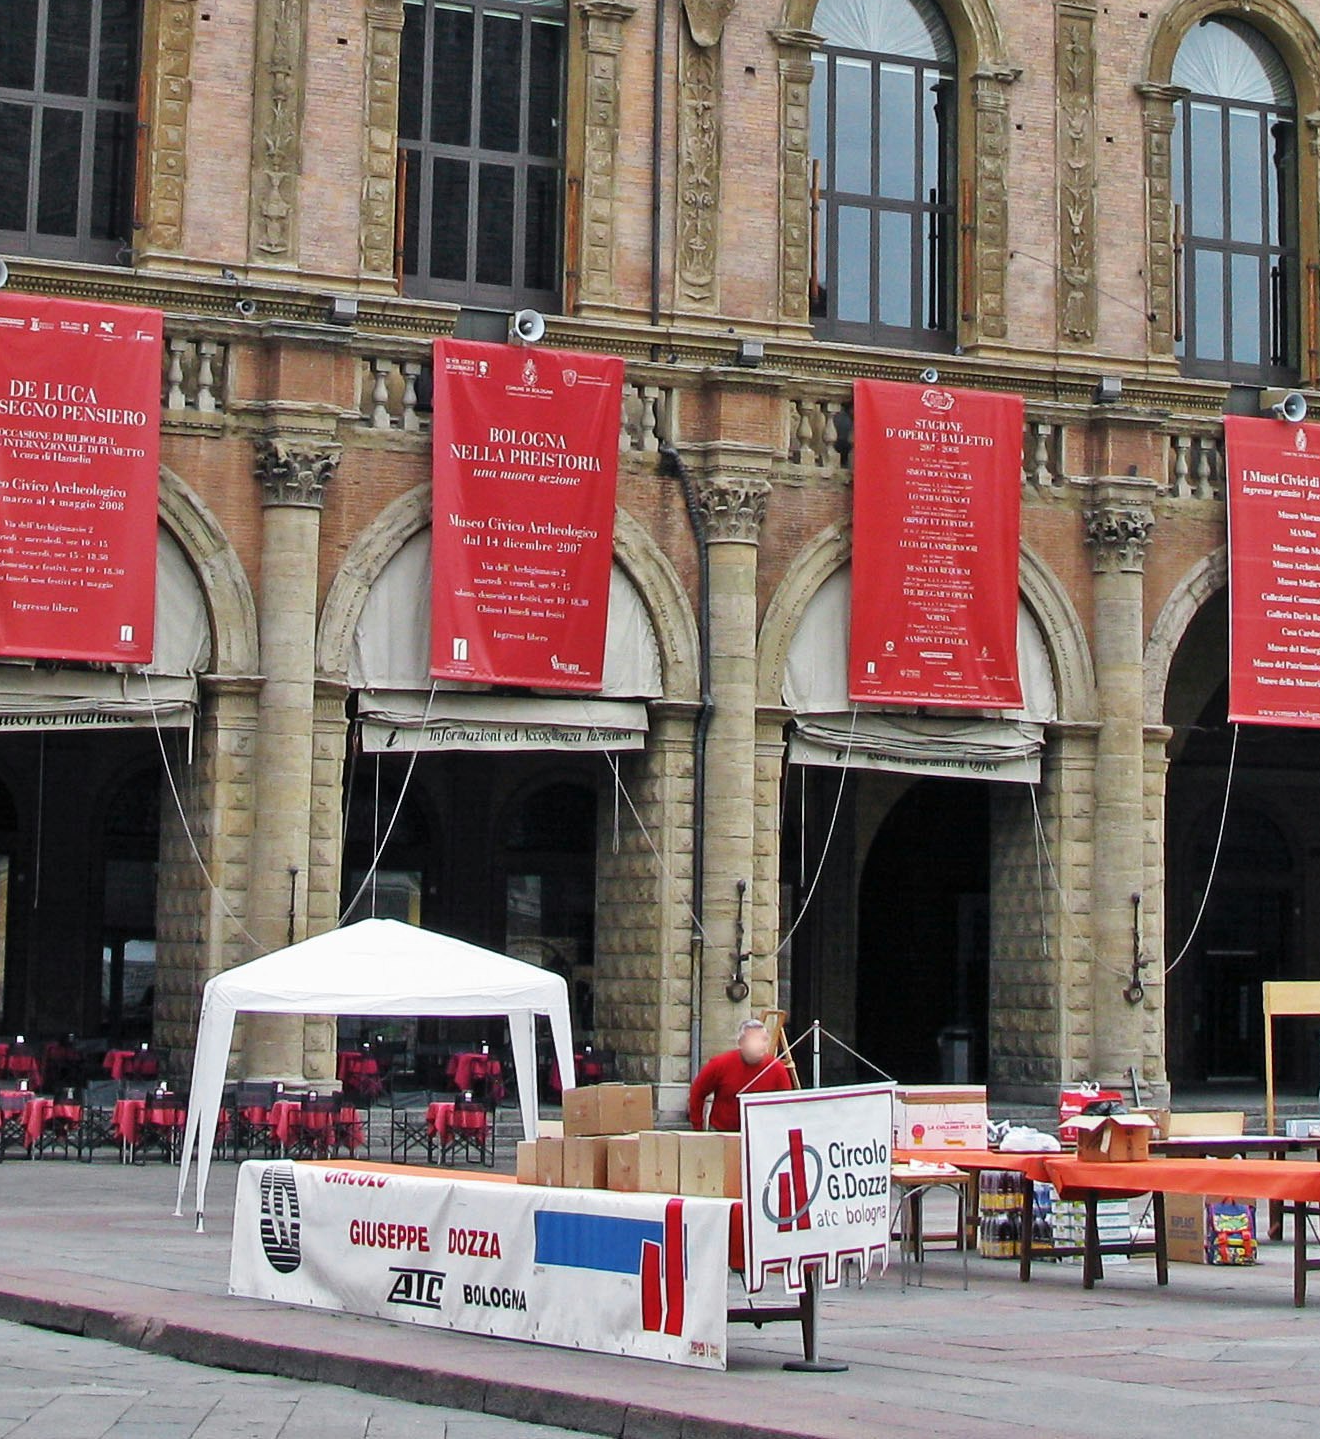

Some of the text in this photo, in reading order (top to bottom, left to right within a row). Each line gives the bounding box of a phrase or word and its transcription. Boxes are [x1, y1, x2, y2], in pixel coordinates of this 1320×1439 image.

[10, 380, 97, 404] DE LUCA
[62, 403, 146, 426] PENSIERO
[915, 420, 962, 432] STAGIONE
[4, 437, 85, 452] INTERNAZIONALE
[88, 445, 98, 453] DI
[100, 446, 144, 457] FUMETTO
[490, 428, 567, 449] BOLOGNA
[898, 430, 930, 441] OPERA
[941, 433, 993, 446] BALLETTO
[53, 454, 91, 464] Hamelin
[449, 444, 601, 472] NELLA PREISTORIA
[473, 469, 581, 486] una nuova sezione
[1243, 470, 1247, 482] I
[1249, 471, 1279, 485] Musei
[1281, 474, 1309, 487] Civici
[1310, 477, 1319, 488] di
[12, 477, 49, 492] Civico
[52, 480, 126, 499] Archeologico
[2, 495, 33, 504] marzo
[37, 495, 45, 505] al
[60, 497, 95, 512] maggio
[99, 500, 124, 511] 2008
[449, 514, 598, 540] Museo Civico Archeologico
[463, 535, 582, 554] dal 14 dicembre 2007
[12, 600, 78, 613] Ingresso libero
[493, 630, 524, 642] Ingresso
[1282, 627, 1297, 636] Casa
[429, 728, 501, 745] Informazioni
[505, 728, 517, 740] ed
[829, 1139, 887, 1168] Circolo
[827, 1173, 887, 1200] G.Dozza
[846, 1203, 886, 1226] bologna
[349, 1220, 501, 1259] GIUSEPPE DOZZA
[386, 1266, 527, 1311] ATC BOLOGNA
